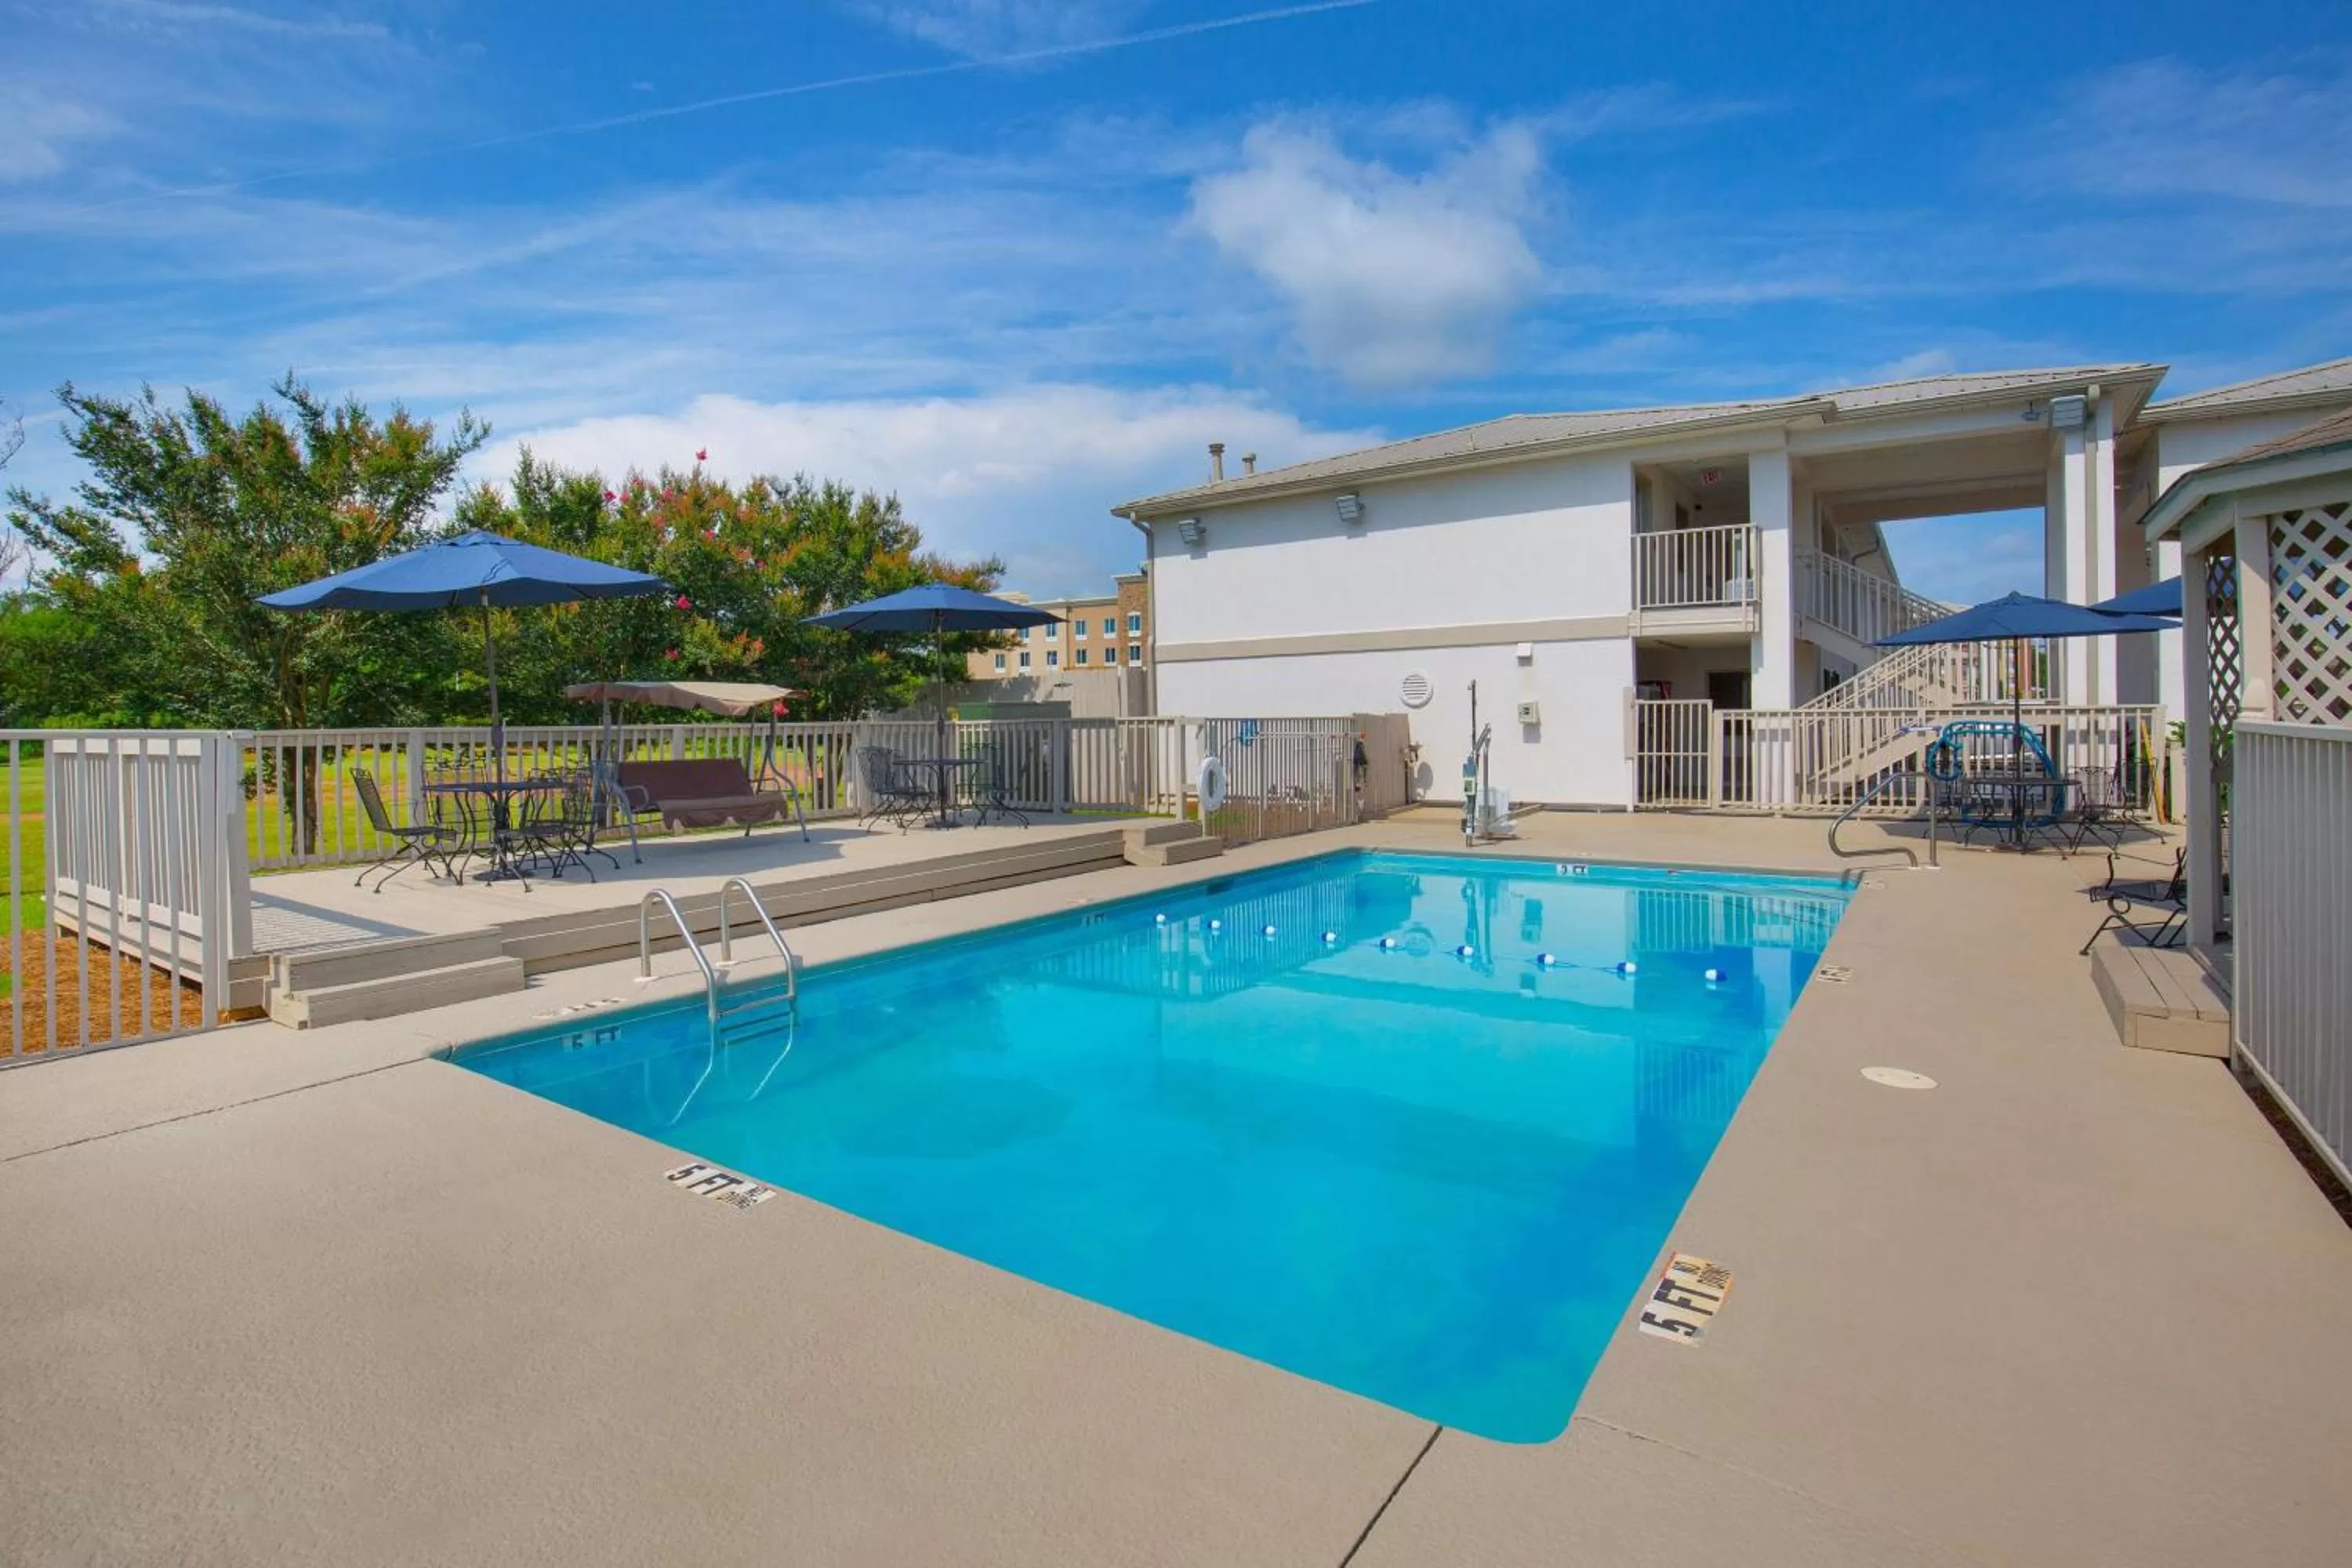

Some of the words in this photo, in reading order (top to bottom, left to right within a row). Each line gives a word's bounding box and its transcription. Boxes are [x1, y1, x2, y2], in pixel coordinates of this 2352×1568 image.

[595, 1027, 620, 1045] FT
[667, 1164, 707, 1181] 5
[686, 1173, 743, 1195] FT
[1653, 1278, 1719, 1316] FT
[1641, 1312, 1698, 1337] 5
